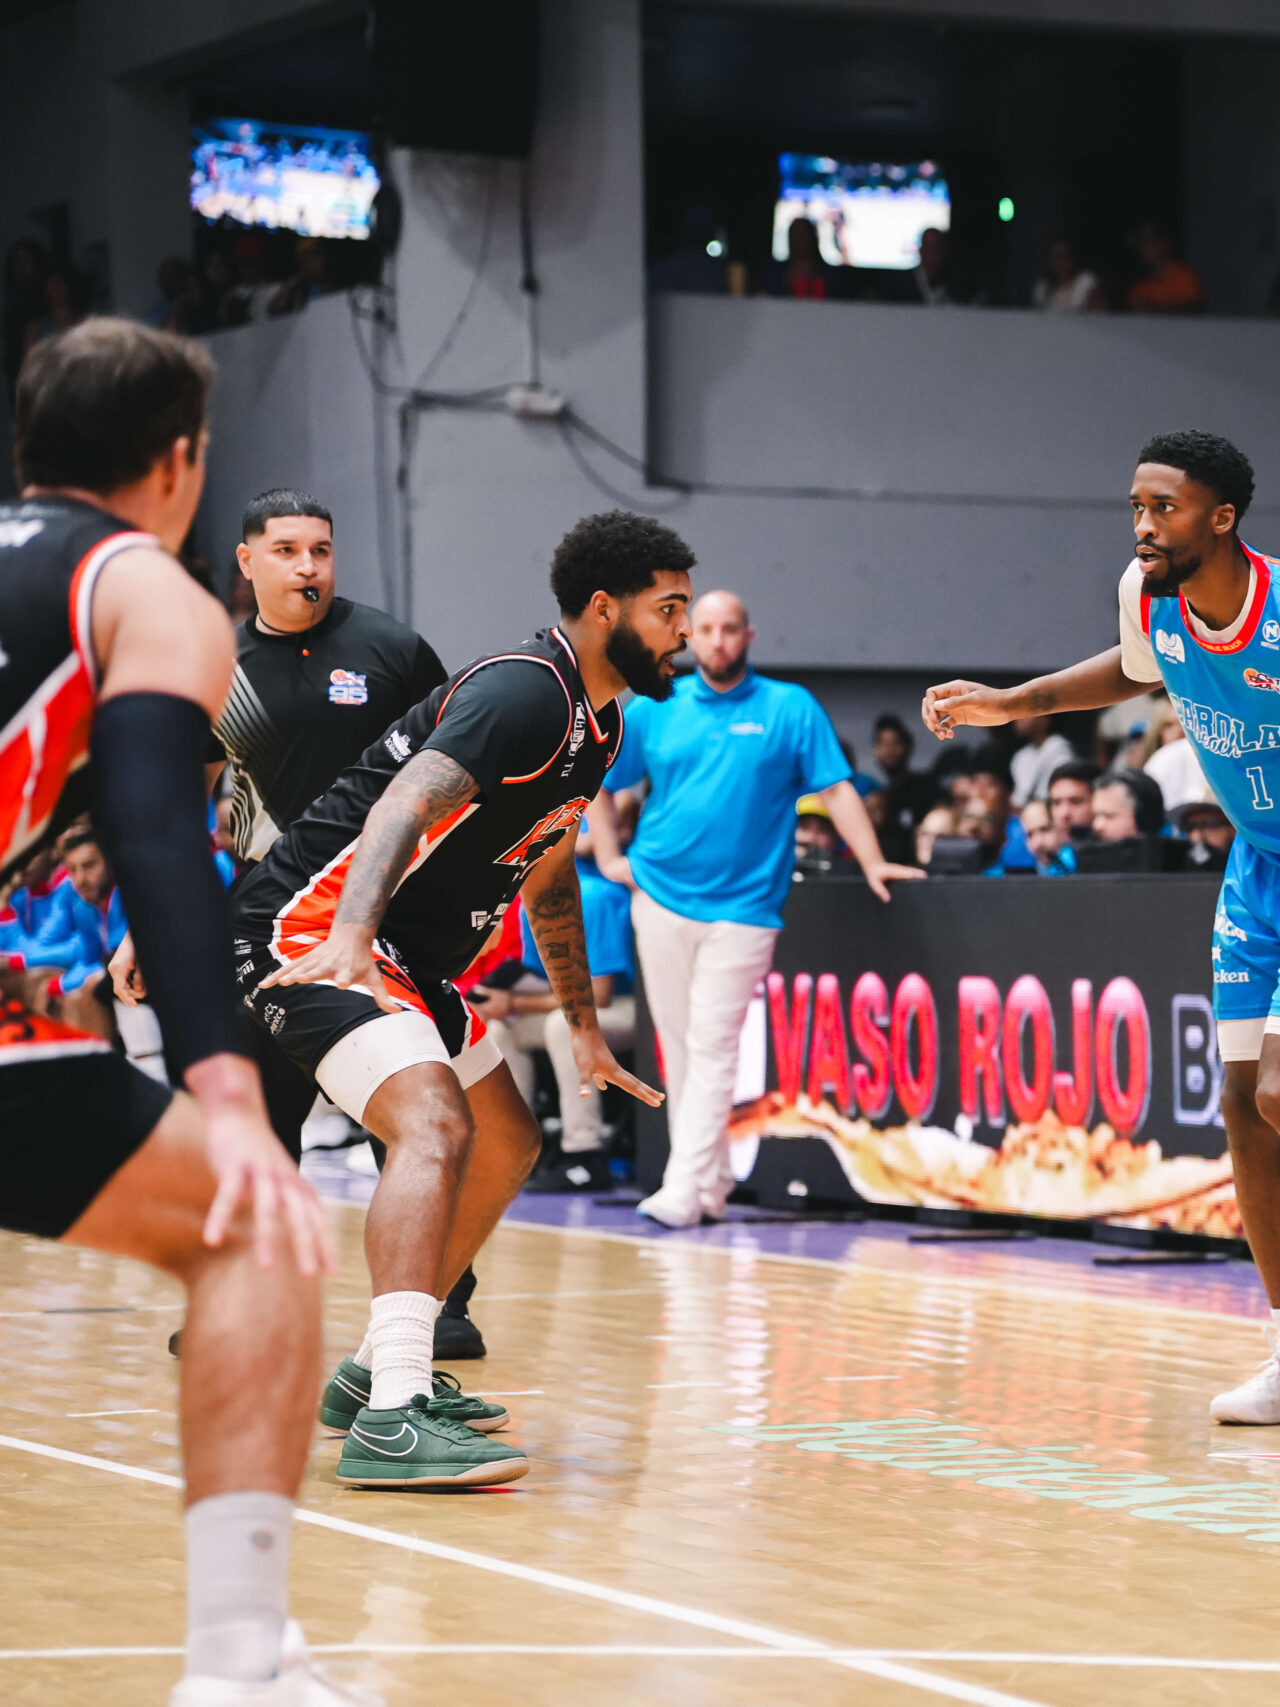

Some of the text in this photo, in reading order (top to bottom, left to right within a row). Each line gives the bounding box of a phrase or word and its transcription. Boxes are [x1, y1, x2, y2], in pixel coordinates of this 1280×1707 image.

[328, 685, 369, 703] 95
[1246, 766, 1274, 811] 1
[766, 971, 939, 1121] VASO
[957, 974, 1152, 1138] ROJO
